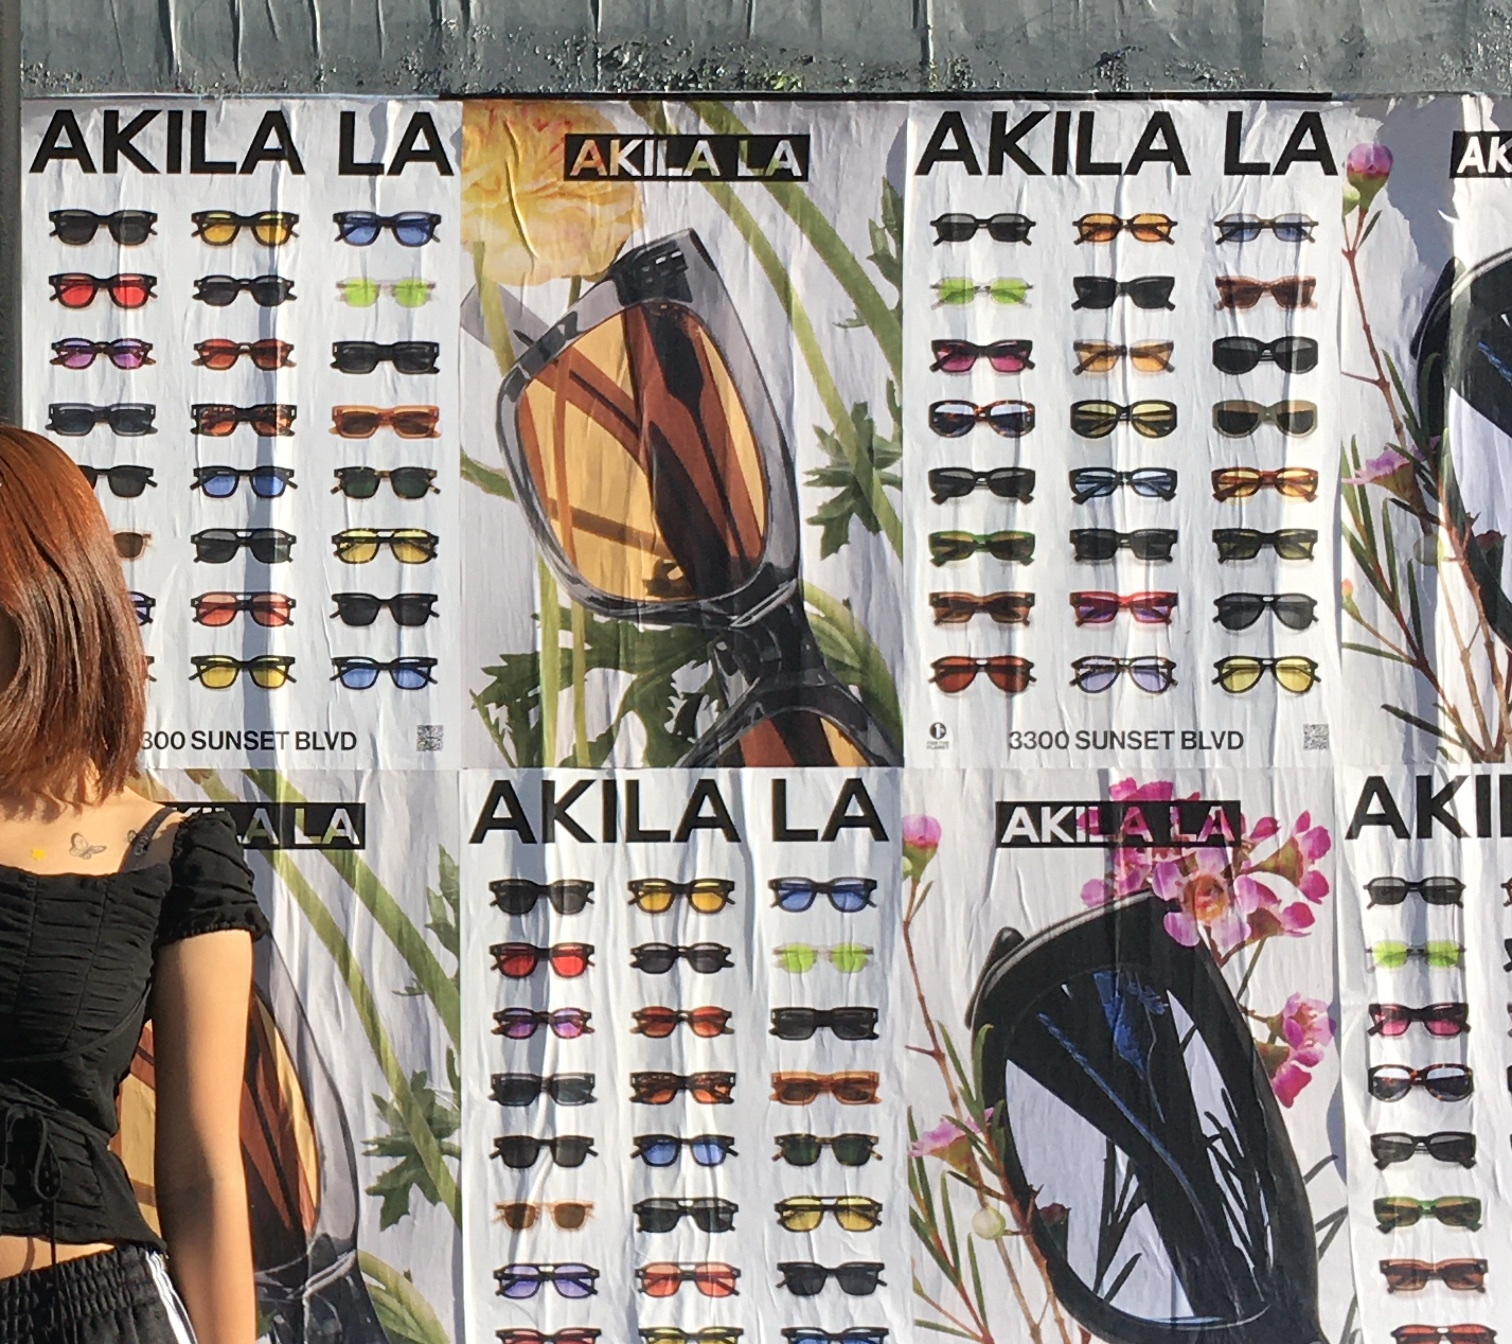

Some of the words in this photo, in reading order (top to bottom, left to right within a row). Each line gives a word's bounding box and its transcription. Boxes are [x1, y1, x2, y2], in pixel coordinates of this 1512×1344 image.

[29, 109, 305, 175] AKILA
[338, 110, 454, 176] LA
[569, 139, 720, 178] AKILA
[738, 139, 803, 178] LA
[916, 110, 1191, 176] AKILA
[1223, 110, 1338, 176] LA
[191, 730, 290, 750] SUNSET
[296, 731, 357, 750] BLVD
[1008, 730, 1070, 750] 3300
[1075, 729, 1175, 750] SUNSET
[1180, 729, 1244, 750] BLVD
[294, 808, 360, 845] LA
[469, 779, 741, 844] AKILA
[772, 778, 889, 843] LA
[1001, 807, 1154, 844] AKILA
[1170, 806, 1237, 843] LA
